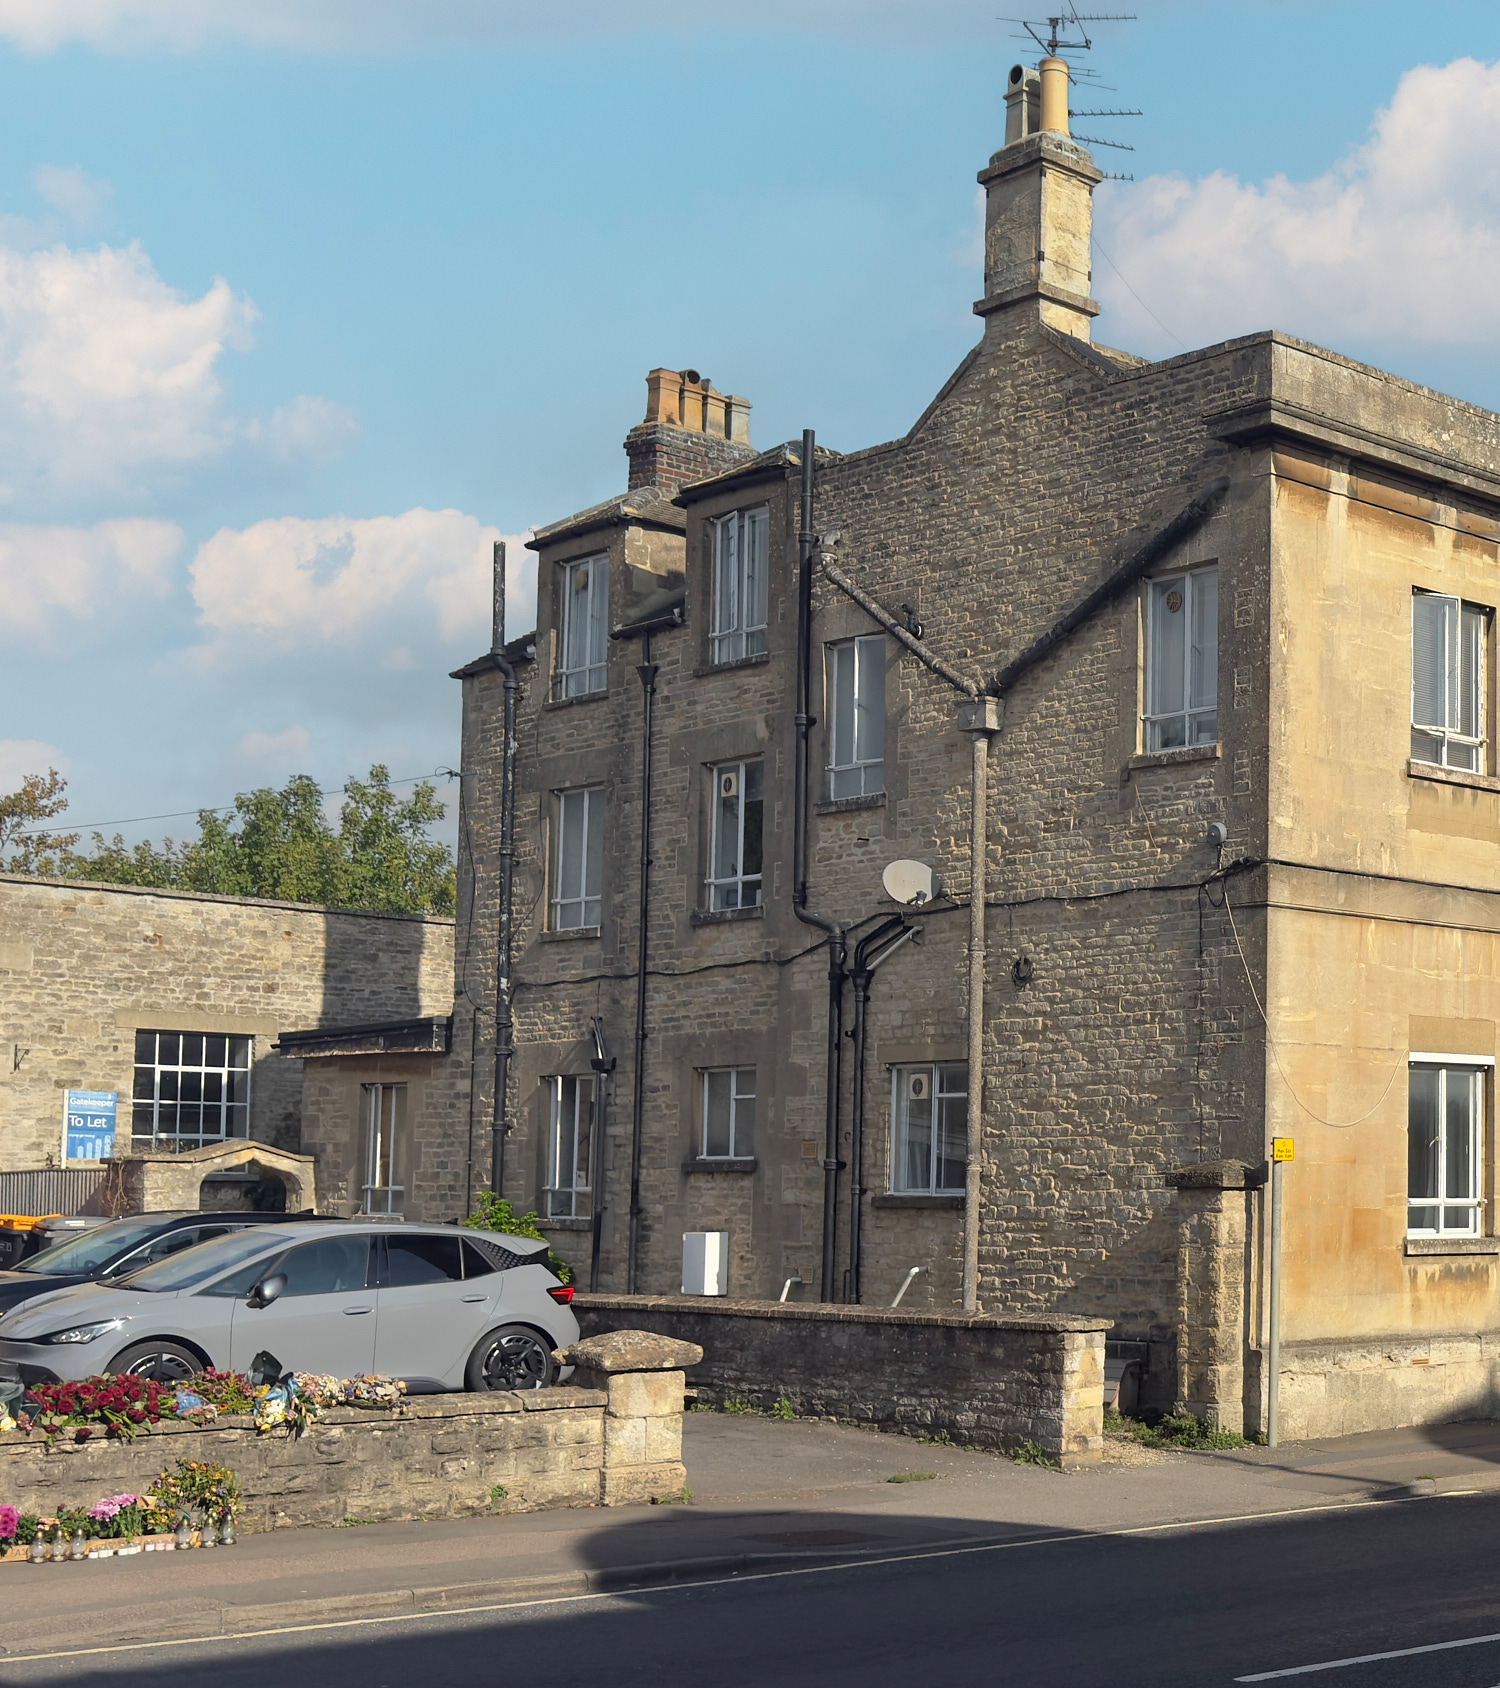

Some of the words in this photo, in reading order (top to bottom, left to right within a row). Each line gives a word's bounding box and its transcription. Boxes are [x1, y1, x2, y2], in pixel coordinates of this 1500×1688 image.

[69, 1097, 115, 1108] Gatekeeper
[68, 1114, 84, 1127] To
[87, 1115, 107, 1128] Let
